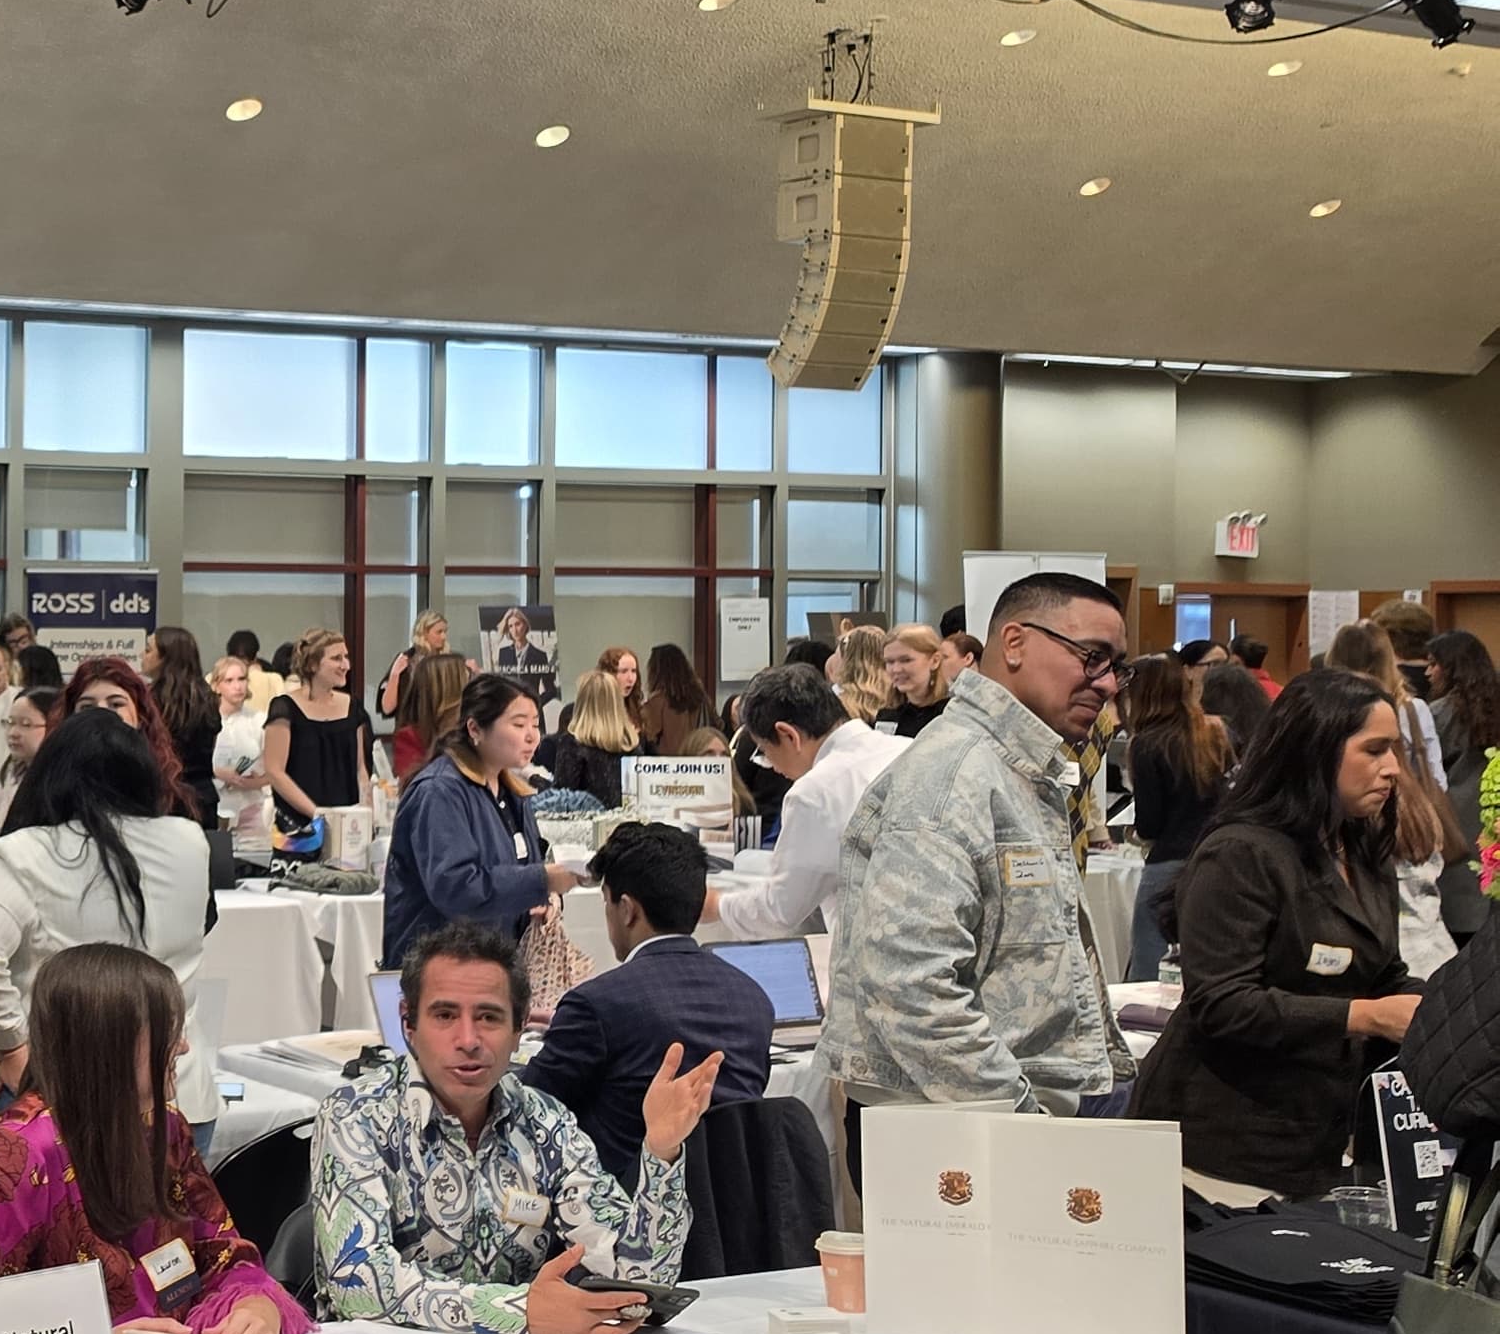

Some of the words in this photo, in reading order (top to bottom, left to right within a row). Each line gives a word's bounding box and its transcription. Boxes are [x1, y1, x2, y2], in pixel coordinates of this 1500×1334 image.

[1229, 524, 1257, 551] EXIT
[32, 593, 95, 613] ROSS
[634, 763, 669, 774] COME
[673, 763, 701, 774] JOIN
[705, 763, 725, 774] US!
[512, 1198, 541, 1212] MIKE
